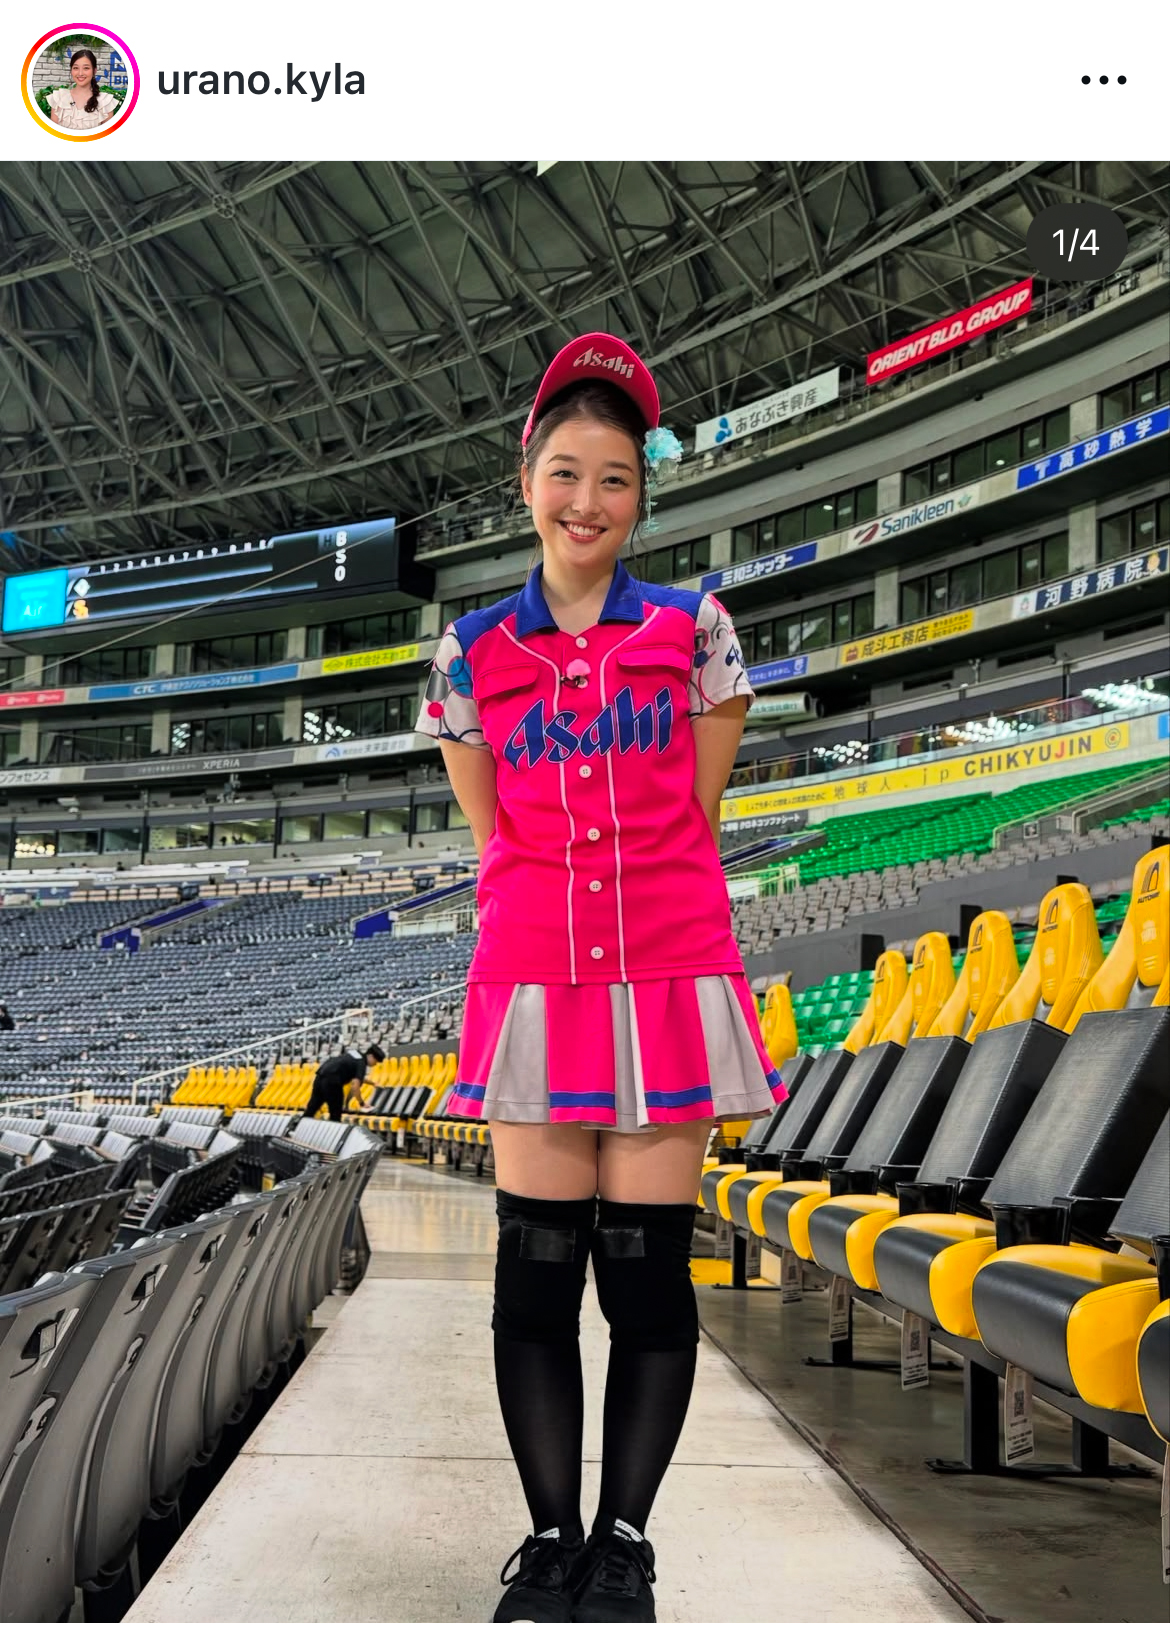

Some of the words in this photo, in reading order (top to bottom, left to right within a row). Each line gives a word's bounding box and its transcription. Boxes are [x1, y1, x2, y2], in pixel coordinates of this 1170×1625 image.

[869, 335, 930, 377] ORIENT
[927, 320, 965, 350] BLD.
[966, 288, 1030, 332] GROUP
[573, 346, 635, 379] Asahi
[881, 499, 954, 537] Sanikleen
[721, 553, 794, 586] 三和シャッター
[1044, 558, 1144, 608] 河野病院
[861, 625, 929, 658] 成斗工務店
[133, 684, 157, 695] CTC
[503, 685, 674, 773] Asahi
[203, 759, 240, 770] XPERIA
[964, 735, 1092, 776] CHIKYUJIN
